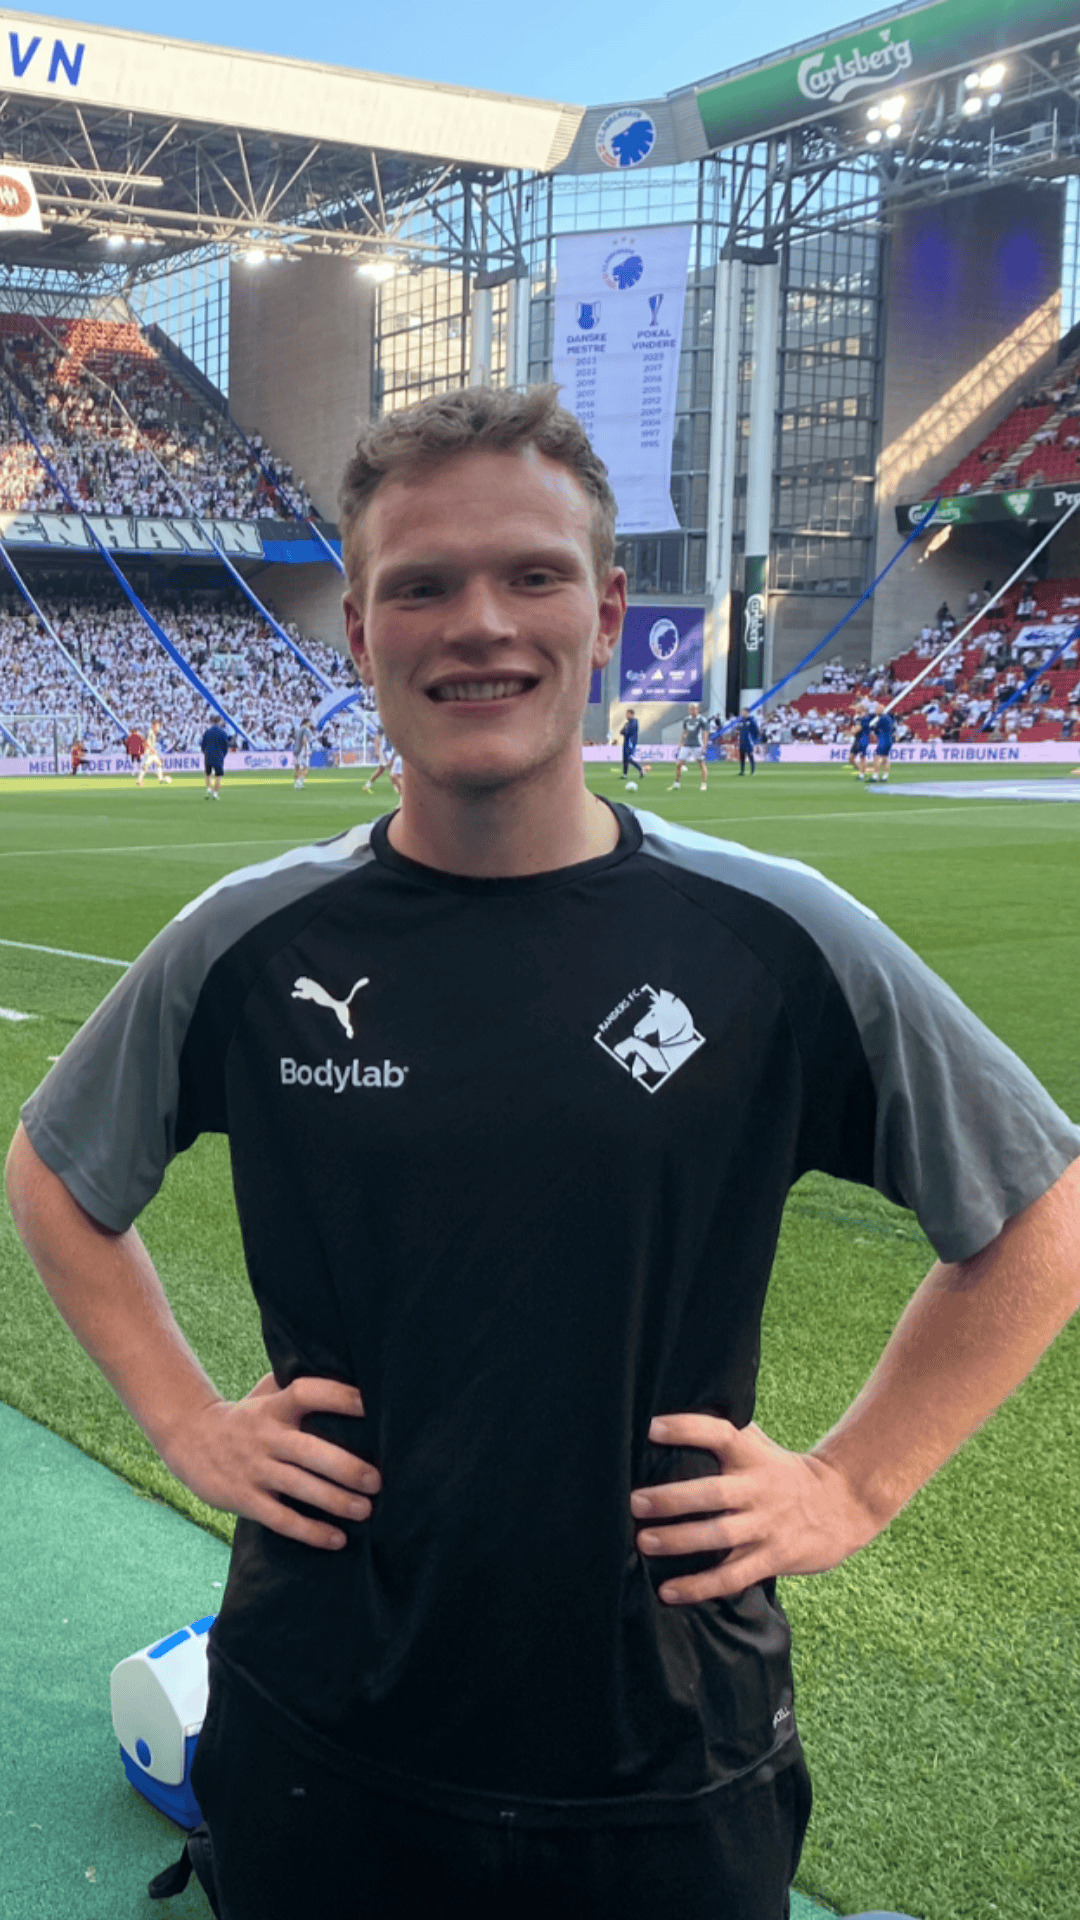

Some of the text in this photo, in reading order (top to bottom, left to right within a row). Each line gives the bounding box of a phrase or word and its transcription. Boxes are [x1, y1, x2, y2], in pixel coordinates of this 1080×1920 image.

[9, 31, 85, 86] VN
[798, 29, 913, 101] Carlsberg
[566, 333, 607, 343] DANSKE
[637, 329, 671, 339] POKAL
[566, 344, 606, 354] MESTRE
[632, 339, 676, 350] VINDERE
[942, 748, 1019, 760] TRIBUNEN
[598, 988, 641, 1032] RANDERS FC
[280, 1057, 405, 1094] Bodylab
